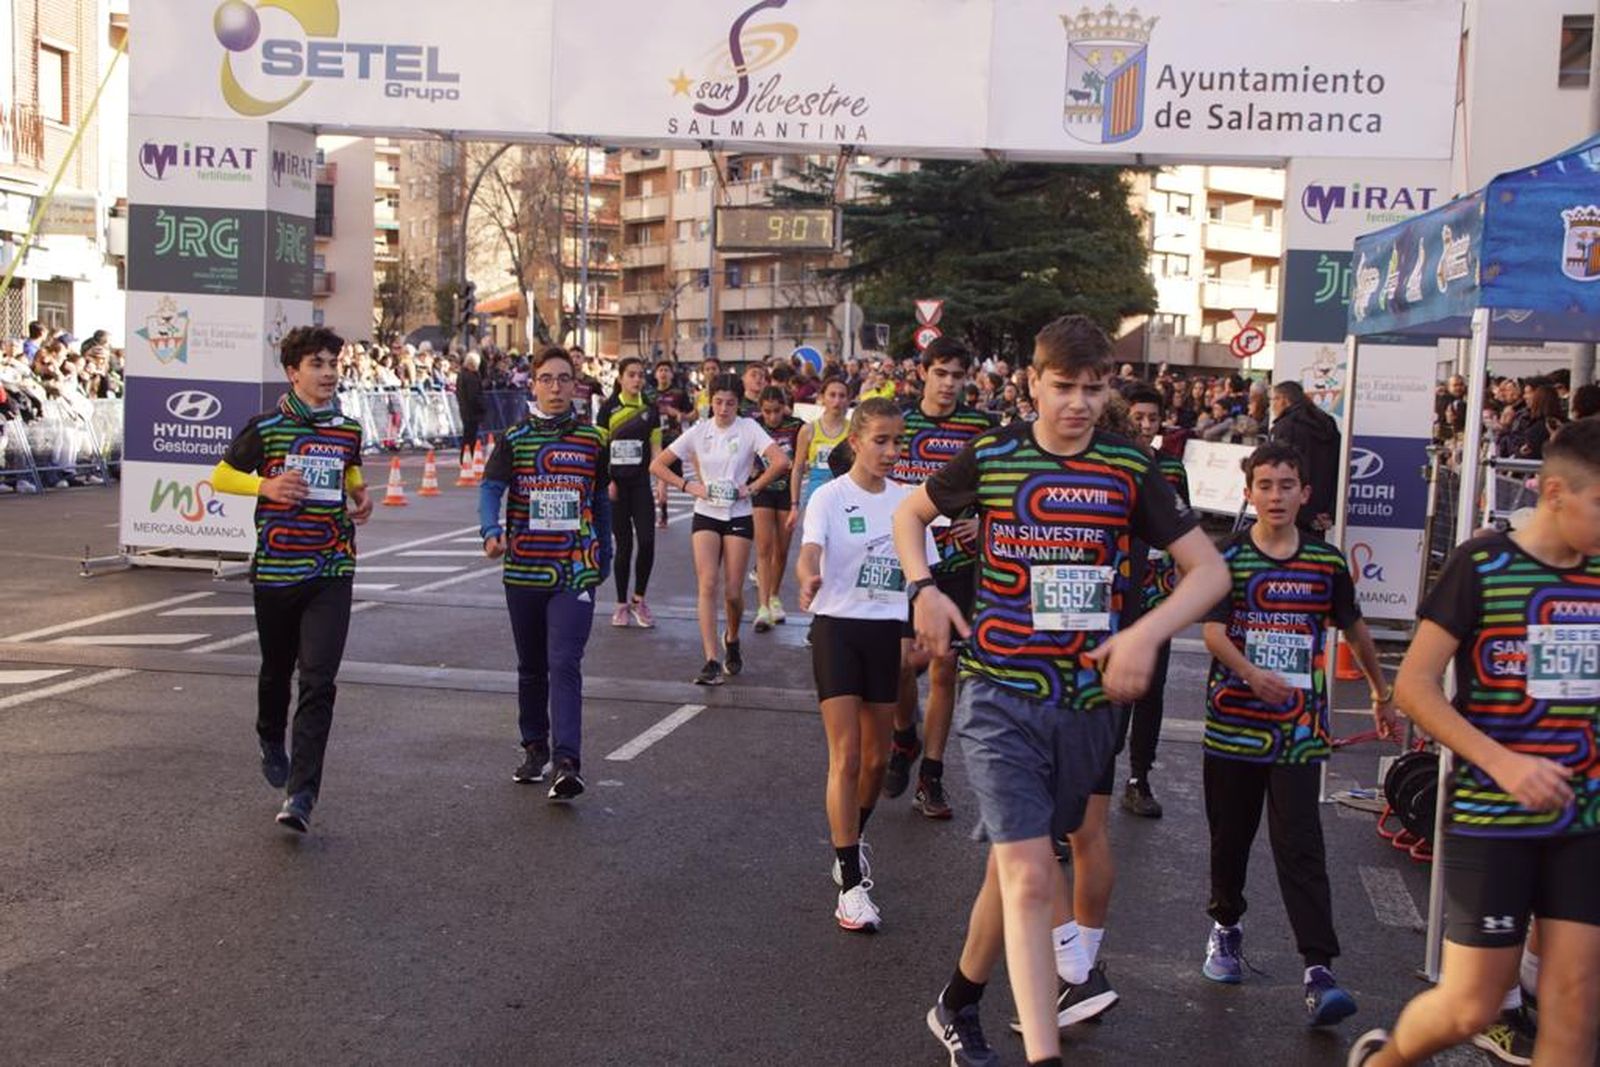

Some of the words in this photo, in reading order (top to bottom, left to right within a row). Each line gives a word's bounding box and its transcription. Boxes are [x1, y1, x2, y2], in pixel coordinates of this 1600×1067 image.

[261, 39, 461, 83] SETEL
[384, 82, 461, 103] Grupo
[1156, 65, 1385, 98] Ayuntamiento
[1154, 101, 1192, 129] de
[1207, 103, 1383, 134] Salamanca
[667, 118, 869, 142] SALMANTINA
[153, 423, 233, 440] HYUNDAI
[1047, 487, 1109, 504] XXXVIII
[538, 500, 568, 517] 5631
[133, 522, 247, 538] MERCASALAMANCA
[993, 523, 1016, 540] SAN
[1019, 525, 1105, 543] SILVESTRE
[993, 542, 1086, 562] SALMANTINA
[861, 565, 892, 587] 5612
[1044, 583, 1096, 609] 5692
[1255, 646, 1298, 669] 5634
[1541, 645, 1599, 674] 5679
